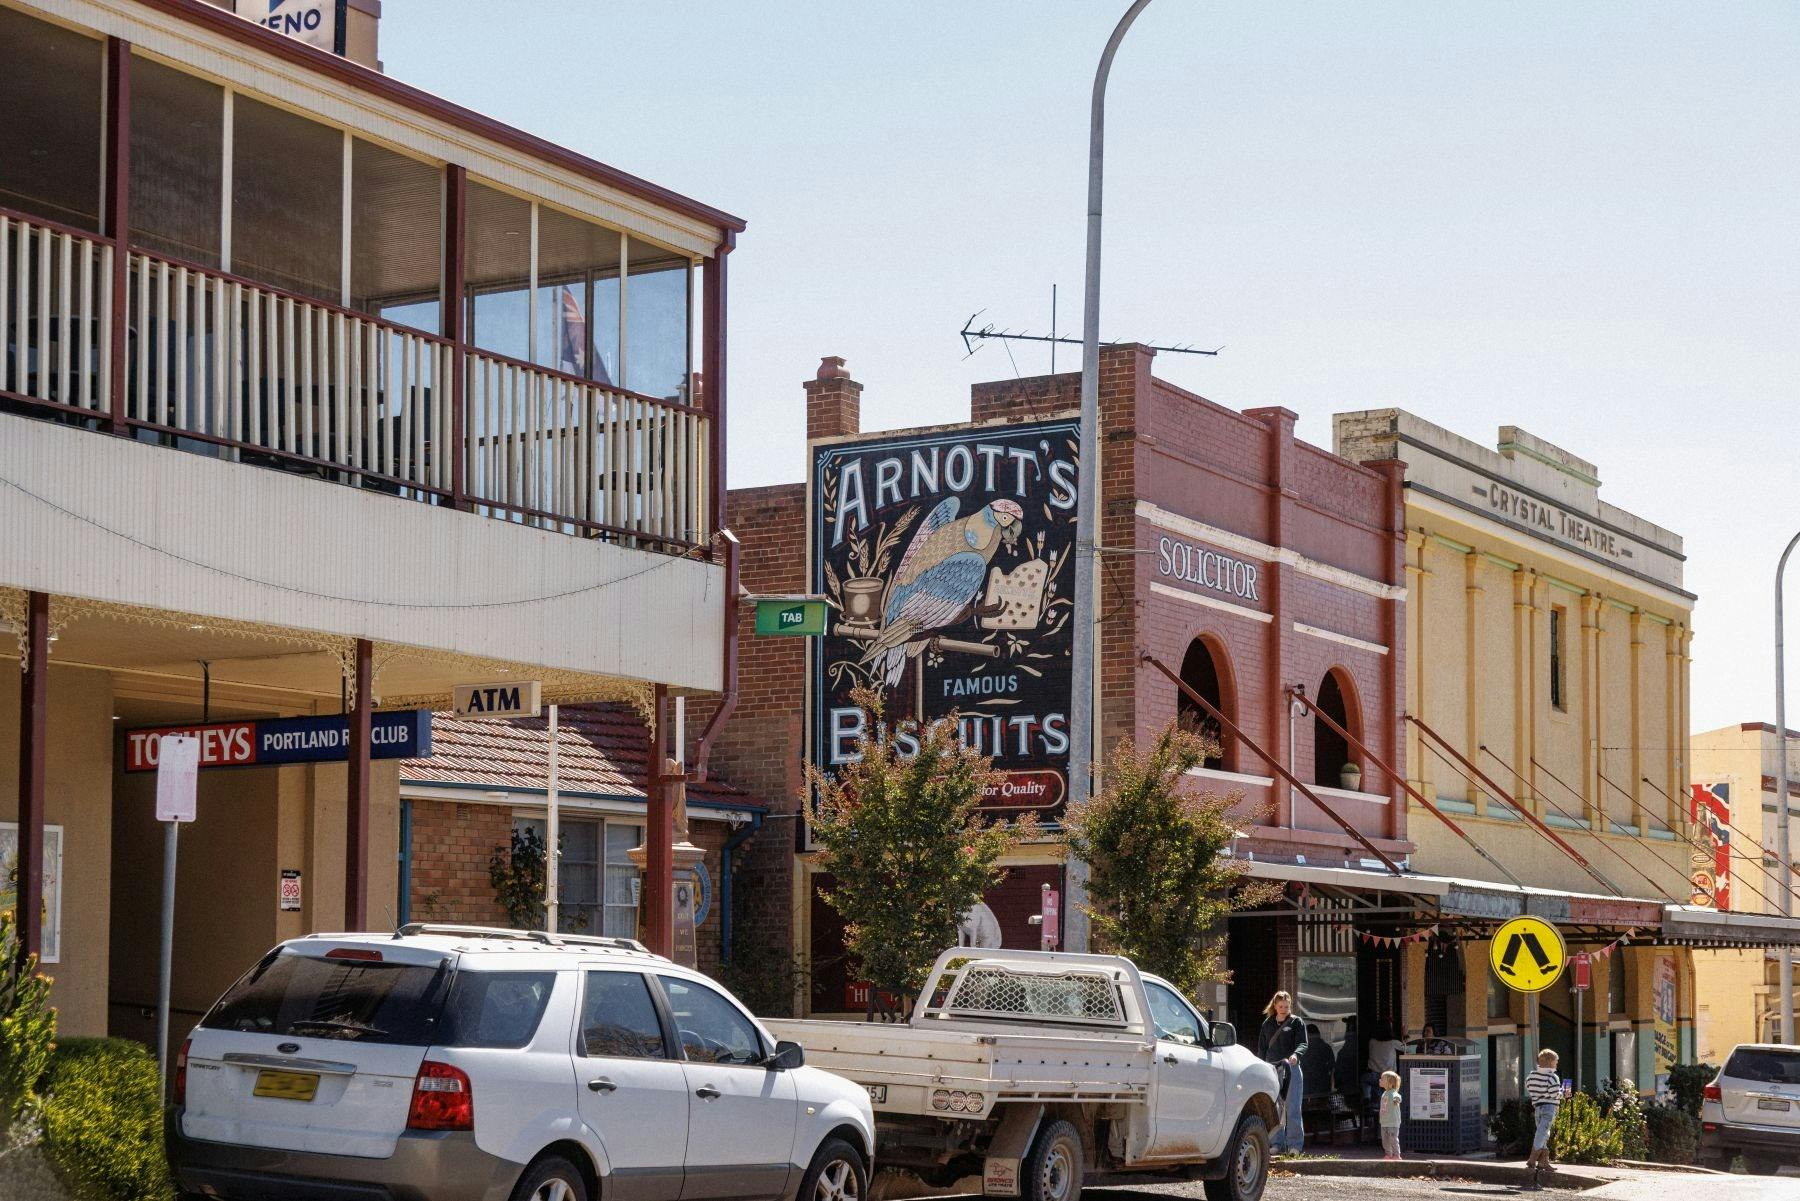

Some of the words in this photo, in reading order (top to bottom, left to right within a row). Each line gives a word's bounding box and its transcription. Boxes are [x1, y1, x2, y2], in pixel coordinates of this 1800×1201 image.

[831, 439, 1078, 549] ARNOTT'S
[1490, 483, 1554, 531] CRYSTAL
[1159, 537, 1259, 601] SOLICITOR
[781, 612, 803, 623] TAB
[943, 674, 1018, 697] FAMOUS
[467, 687, 520, 712] ATM
[130, 727, 251, 766] TOEYS
[263, 730, 339, 751] PORTLAND
[371, 725, 409, 744] CLUB
[1001, 781, 1046, 797] Quality
